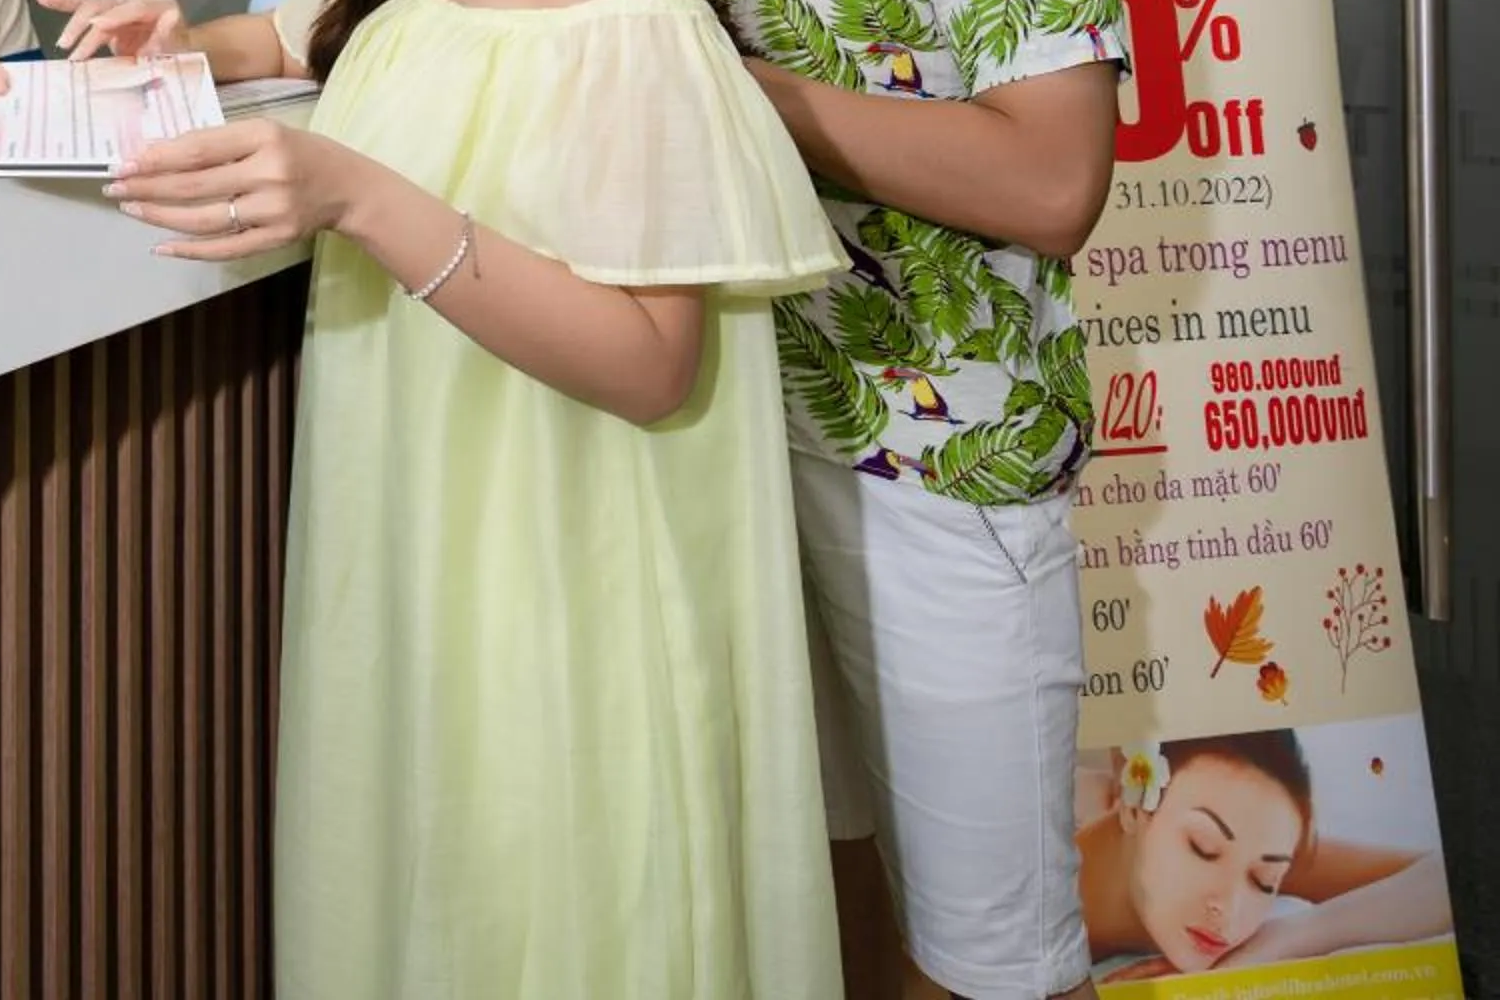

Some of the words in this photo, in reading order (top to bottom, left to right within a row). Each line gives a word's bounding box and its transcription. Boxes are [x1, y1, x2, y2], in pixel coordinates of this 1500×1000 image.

[1187, 100, 1264, 157] off
[1115, 175, 1273, 211] 31.10.2022)
[1088, 243, 1149, 287] spa
[1157, 235, 1250, 279] trong
[1261, 233, 1349, 267] menu
[1171, 297, 1206, 341] in
[1217, 304, 1313, 338] menu
[1102, 472, 1146, 505] cho
[1154, 469, 1184, 500] da
[1191, 468, 1241, 502] mặt
[1248, 462, 1281, 493] 60'
[1116, 529, 1181, 570] bằng
[1187, 527, 1238, 560] tinh
[1248, 519, 1294, 555] dầu
[1300, 518, 1333, 550] 60'
[1093, 598, 1131, 632] 60'
[1132, 655, 1169, 693] 60'
